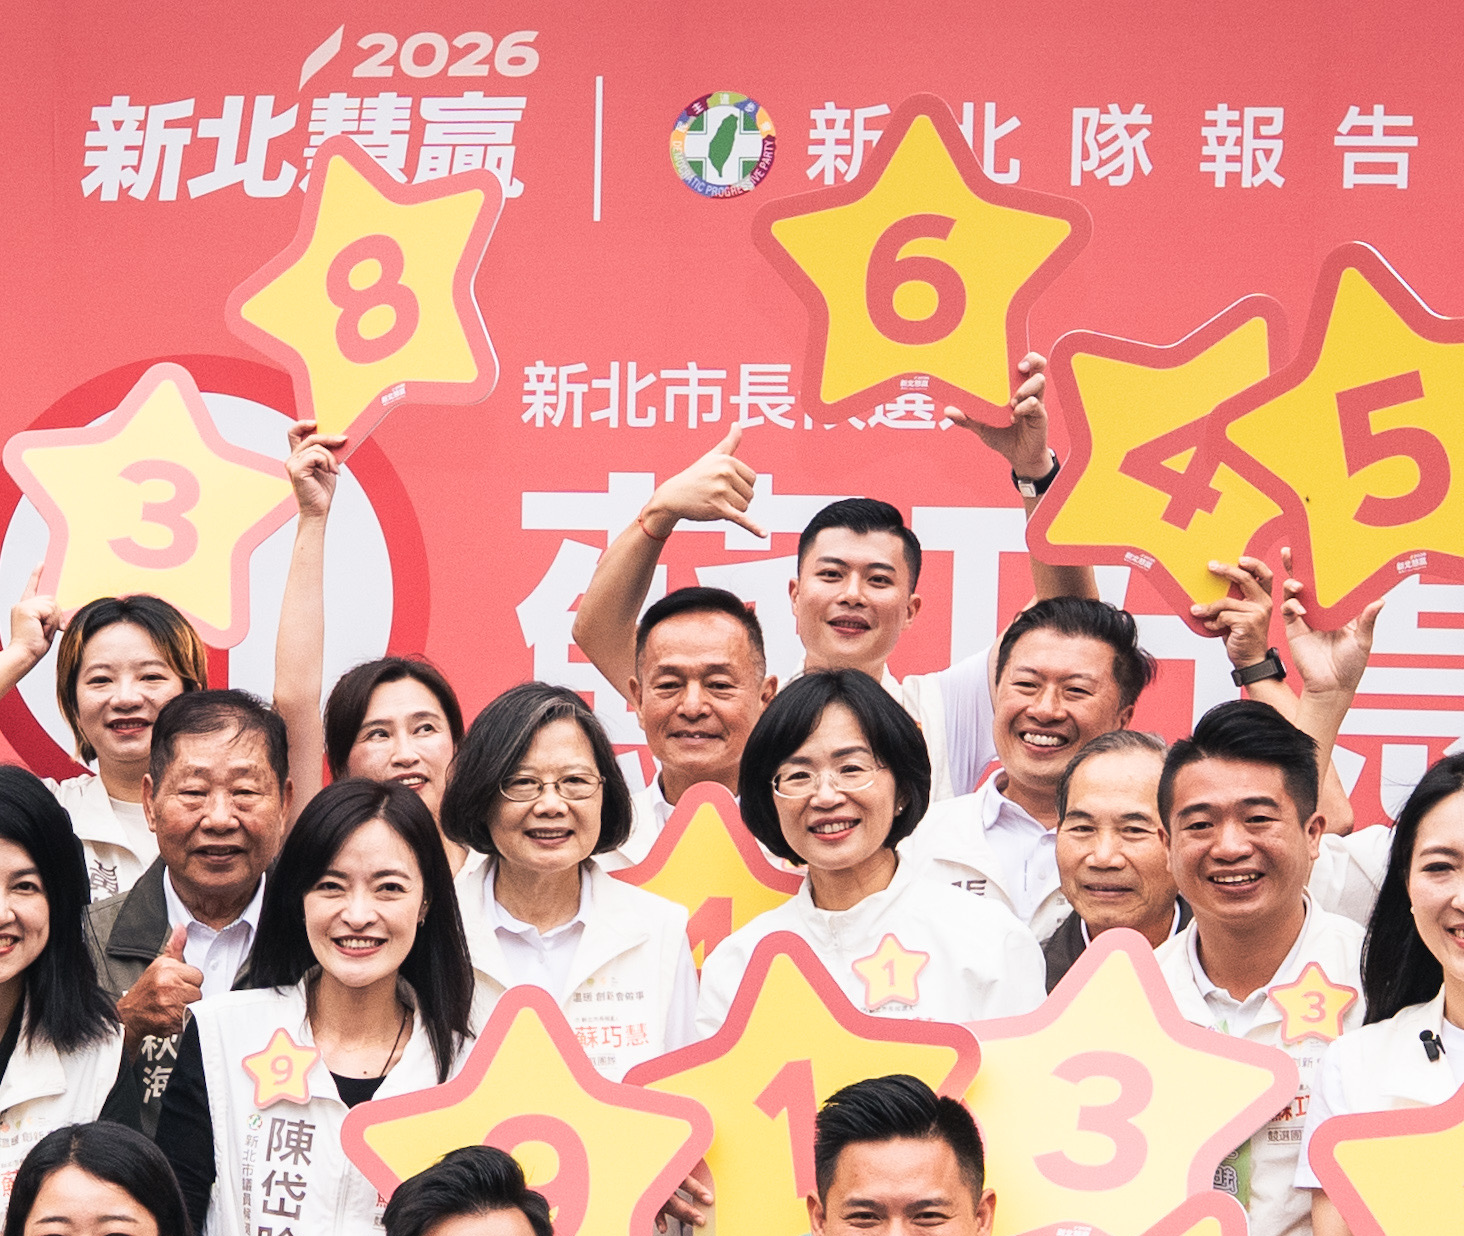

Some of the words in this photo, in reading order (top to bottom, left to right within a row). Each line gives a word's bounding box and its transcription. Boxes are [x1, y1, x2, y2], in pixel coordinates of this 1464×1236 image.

[351, 30, 540, 78] 2026
[81, 91, 527, 201] 新北慧贏
[759, 139, 775, 170] PARTY
[325, 233, 421, 365] 8
[865, 213, 967, 345] 6
[521, 360, 956, 430] 新北市長
[1333, 370, 1452, 528] 5
[107, 460, 201, 570] 3
[1119, 418, 1233, 531] 4
[880, 958, 897, 986] 1
[1301, 990, 1327, 1023] 3
[270, 1055, 294, 1085] 9
[1033, 1050, 1154, 1192] 3
[753, 1058, 819, 1200] 1
